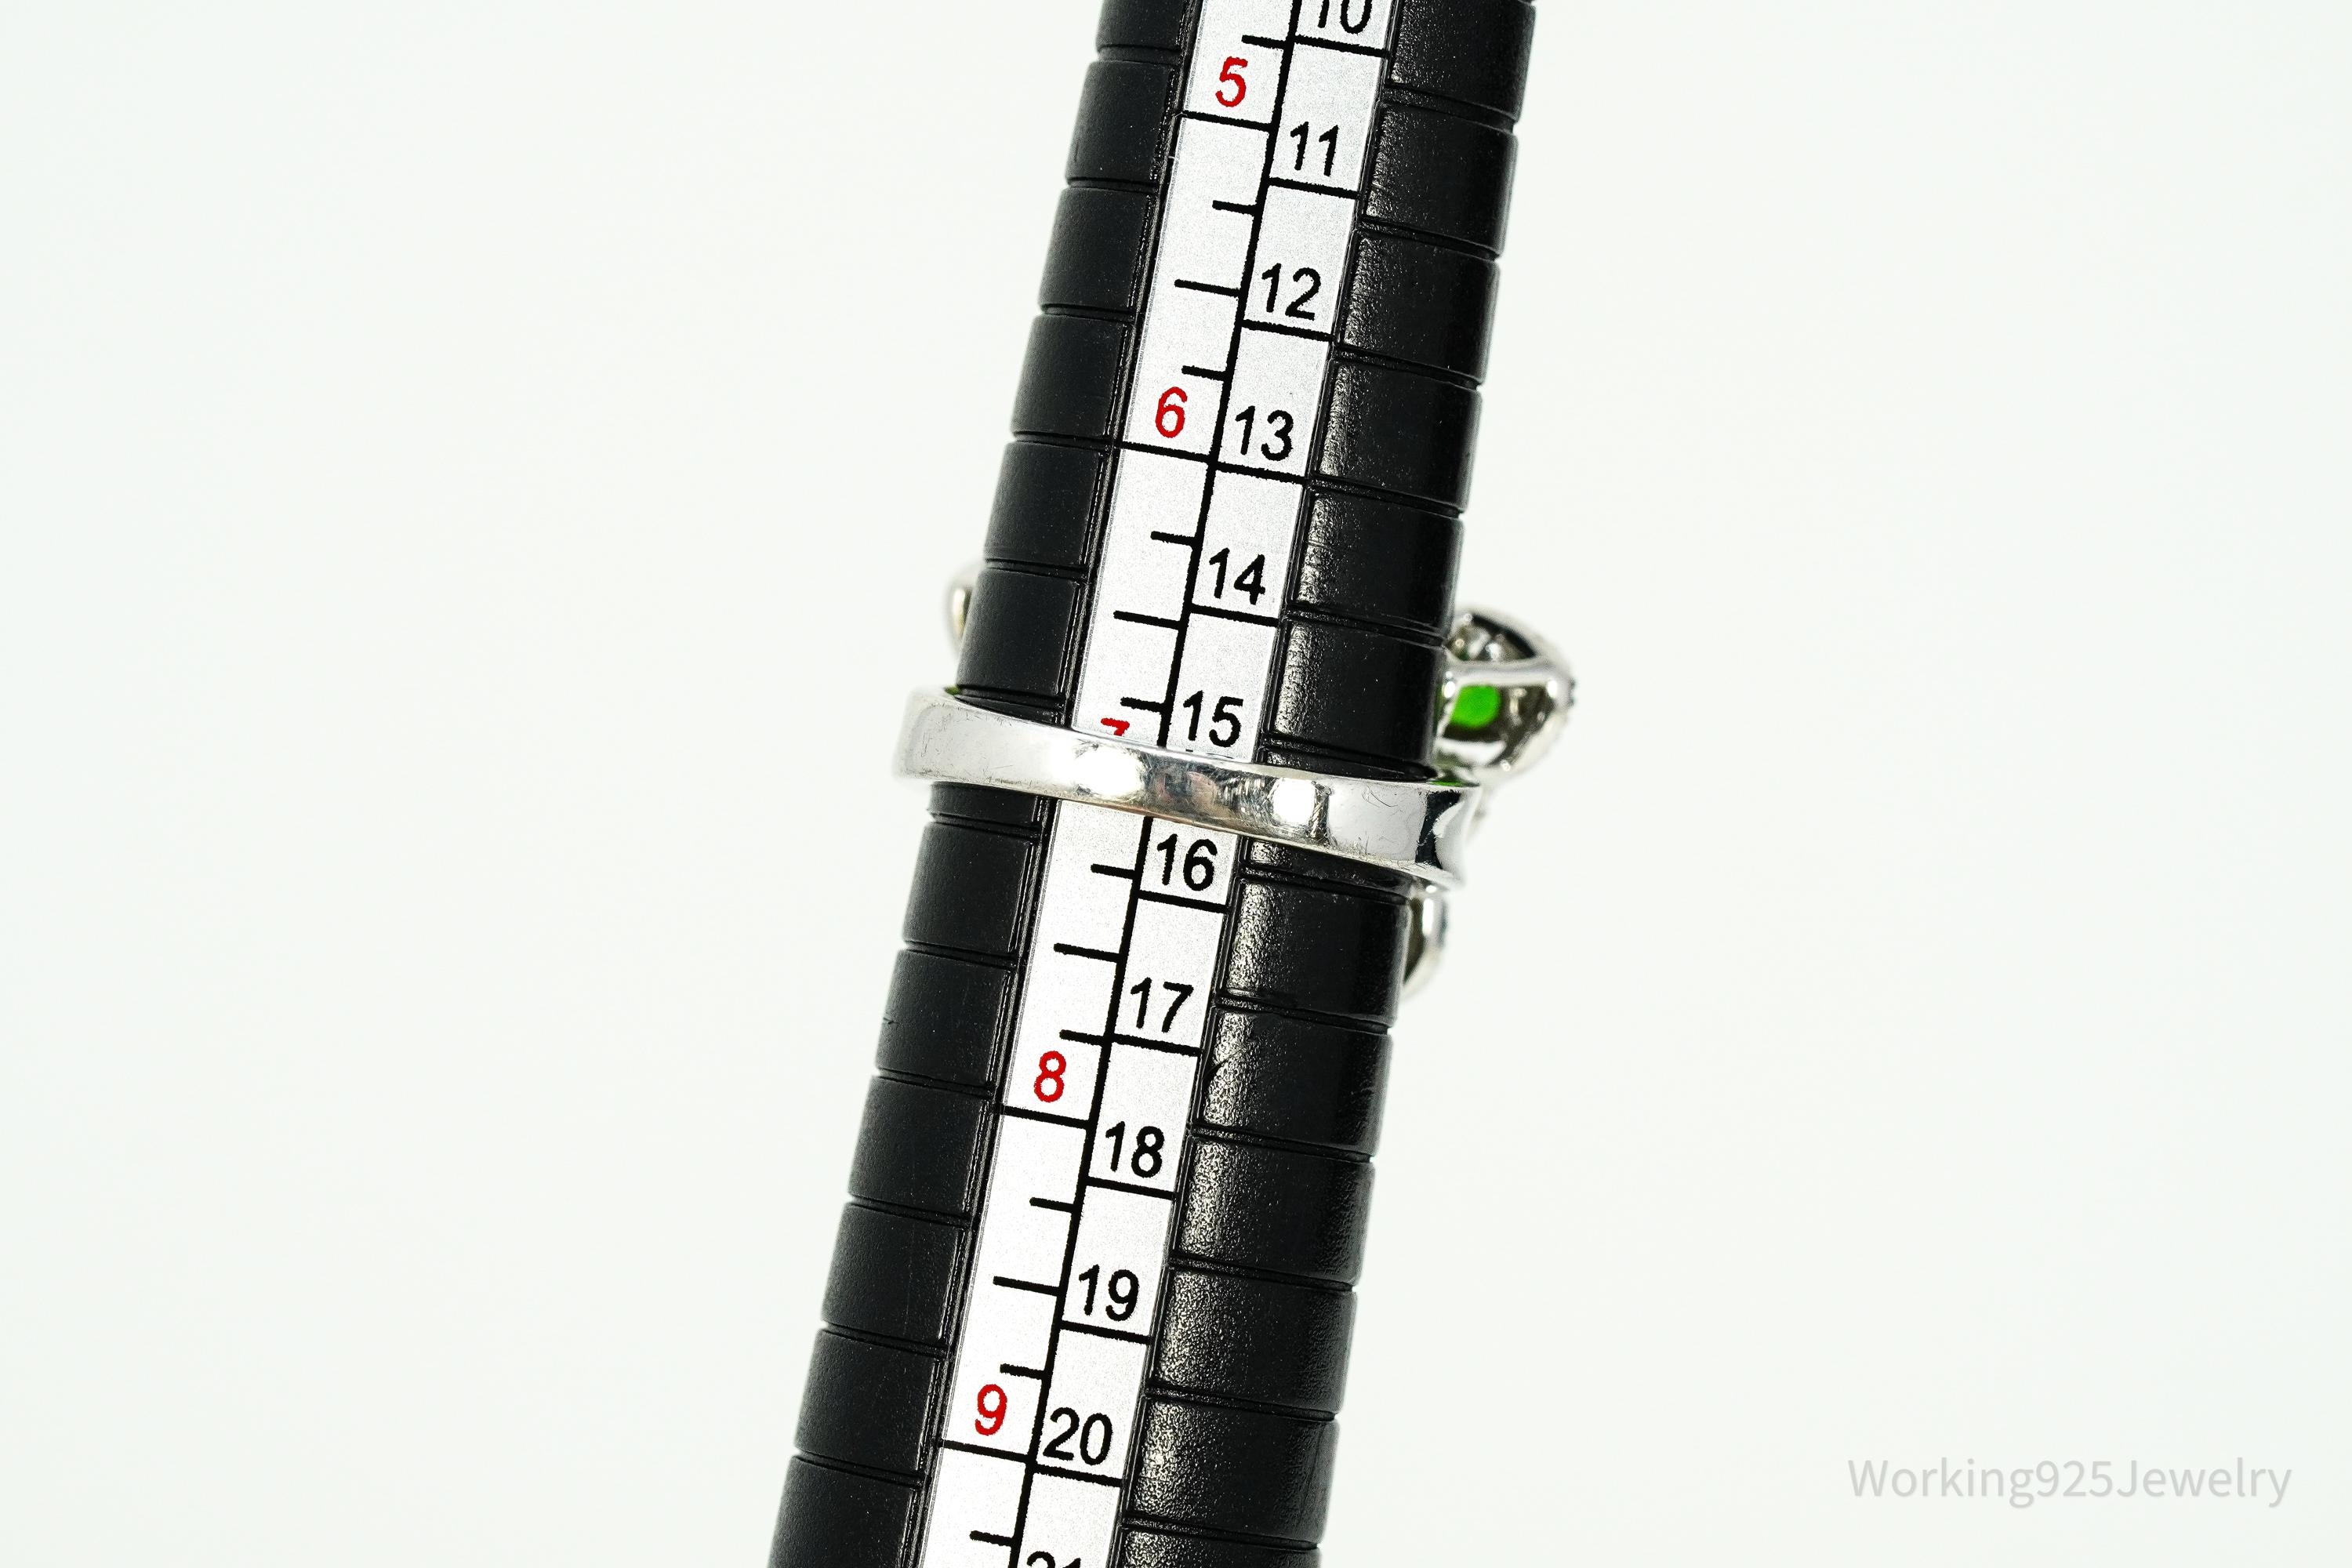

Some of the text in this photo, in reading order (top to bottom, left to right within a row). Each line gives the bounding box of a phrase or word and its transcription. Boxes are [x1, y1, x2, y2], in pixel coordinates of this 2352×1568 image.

[1214, 56, 1249, 108] 5
[1290, 121, 1339, 177] 11
[1261, 263, 1322, 321] 12
[1155, 386, 1188, 439] 6
[1234, 405, 1294, 462] 13
[1208, 547, 1266, 606] 14
[1182, 689, 1244, 749] 15
[1156, 833, 1218, 892] 16
[1130, 976, 1195, 1034] 17
[1033, 1050, 1067, 1103] 8
[1105, 1120, 1165, 1179] 18
[1078, 1264, 1141, 1323] 19
[975, 1383, 1008, 1436] 9
[1042, 1406, 1114, 1466] 20
